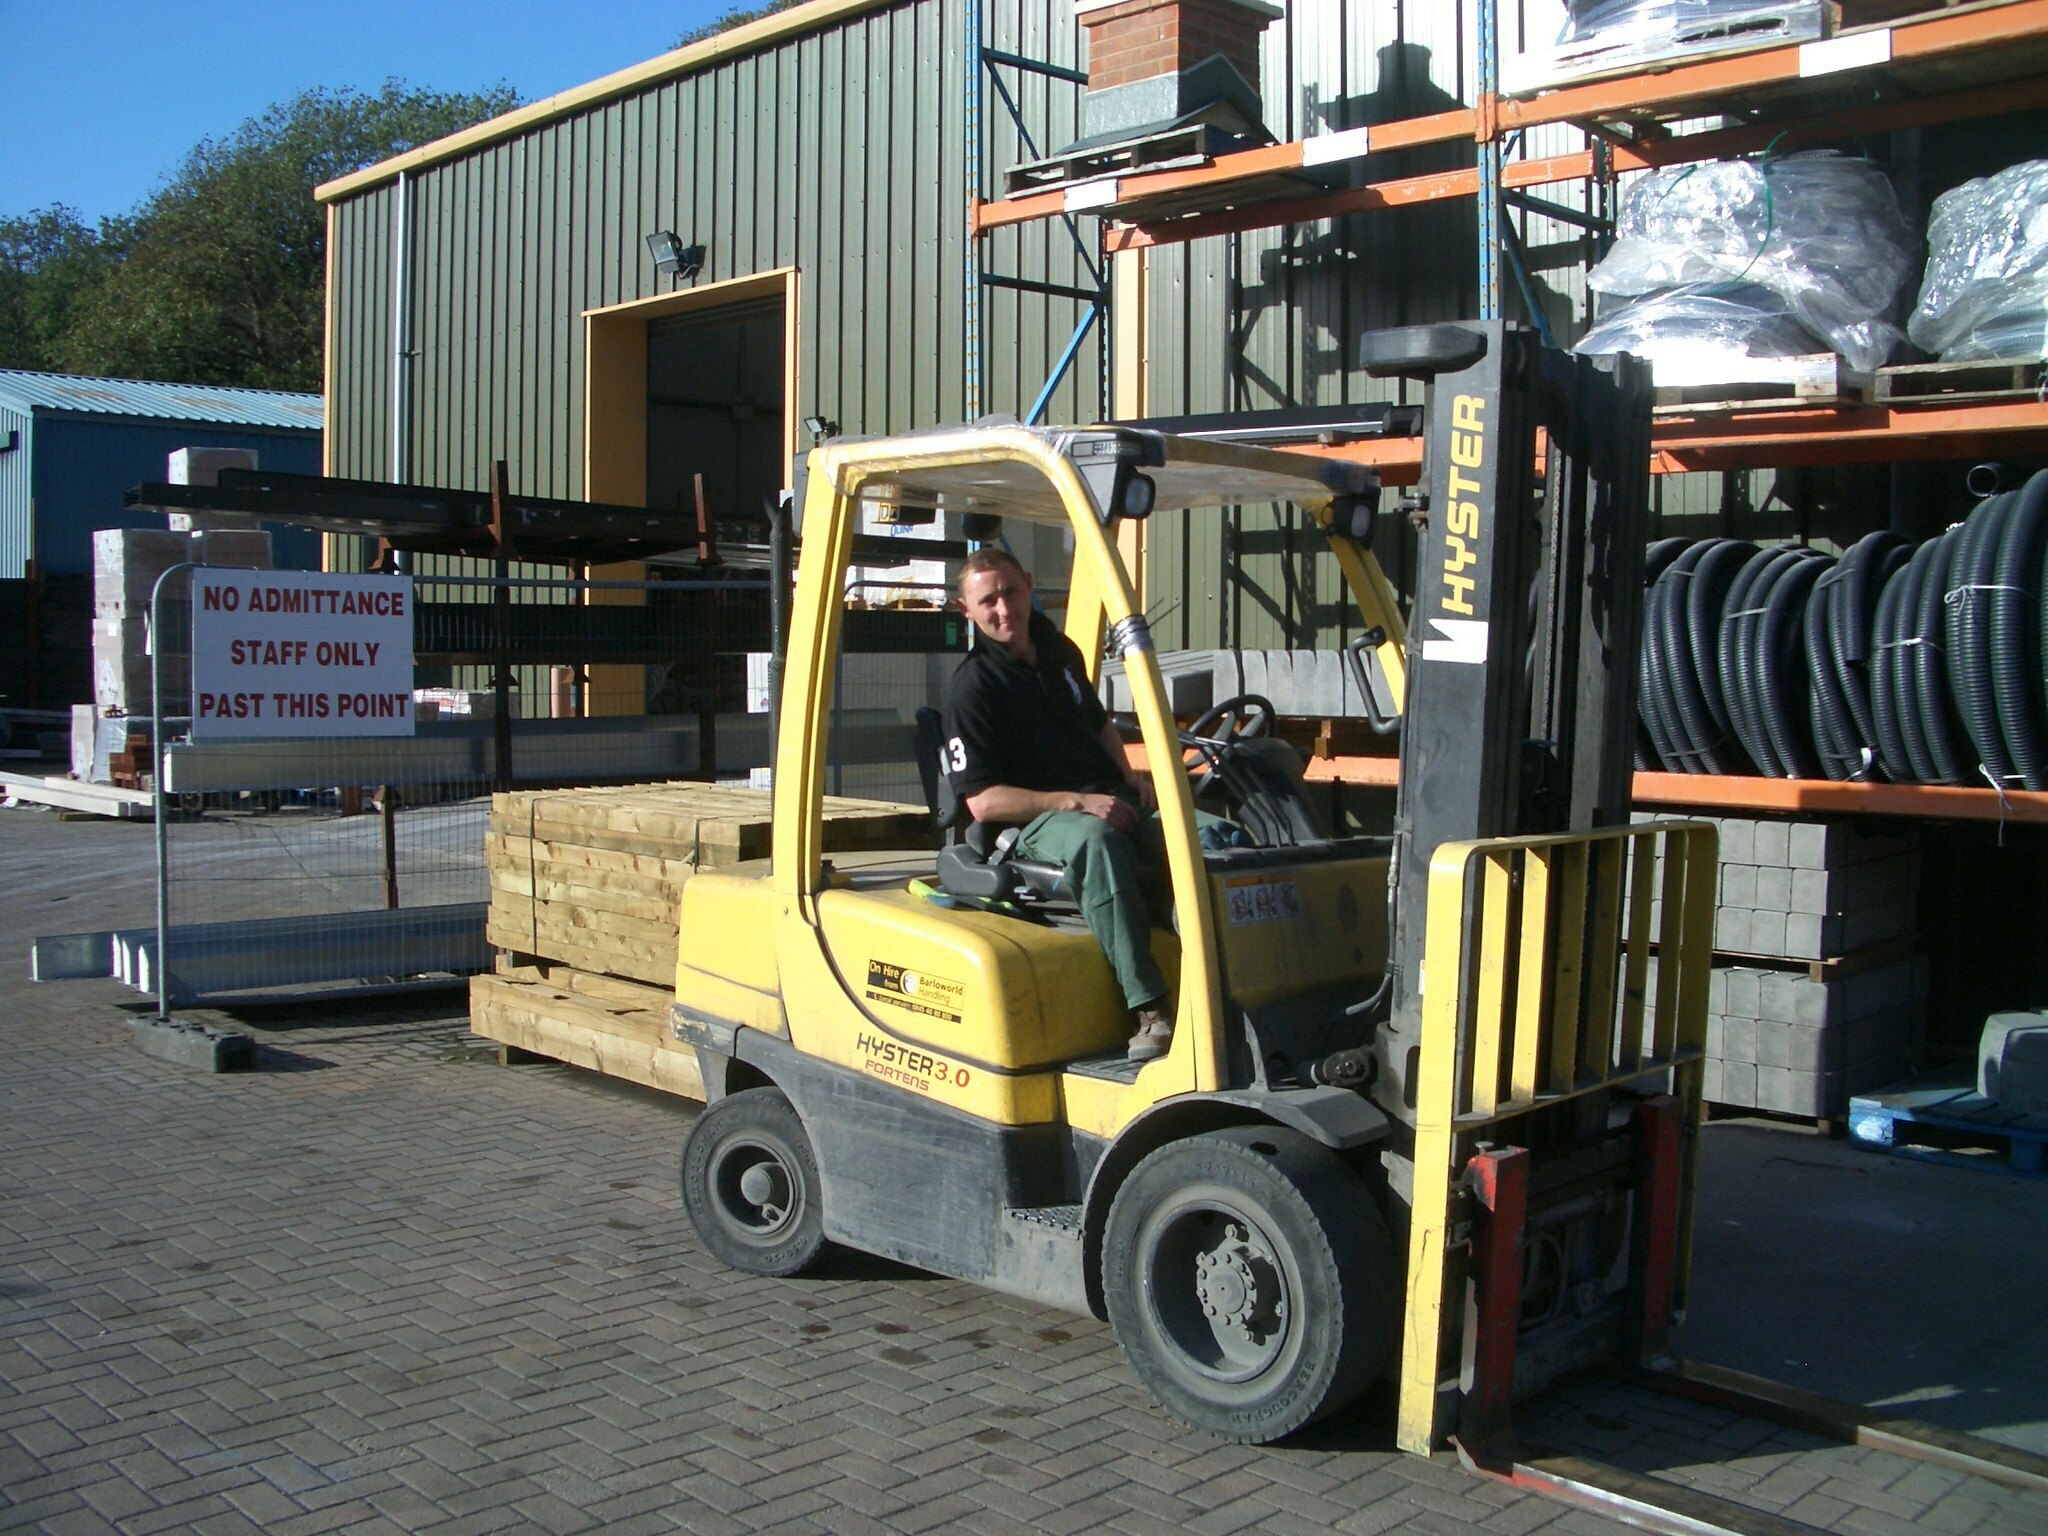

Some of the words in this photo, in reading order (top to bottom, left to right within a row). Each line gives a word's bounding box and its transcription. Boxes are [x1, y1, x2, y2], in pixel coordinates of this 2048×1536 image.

[1441, 394, 1485, 616] HYSTER
[203, 586, 240, 612] NO
[247, 587, 405, 616] ADMITTANCE
[230, 639, 308, 666] STAFF
[315, 641, 381, 667] ONLY
[199, 692, 265, 719] PAST
[272, 693, 330, 718] THIS
[337, 693, 409, 718] POINT
[869, 961, 882, 975] On
[883, 964, 900, 979] Hire
[919, 976, 964, 996] Barloworld
[919, 986, 951, 1007] Handling
[856, 1032, 934, 1077] HYSTER
[934, 1061, 970, 1088] 3.0
[865, 1058, 931, 1092] FORTENS
